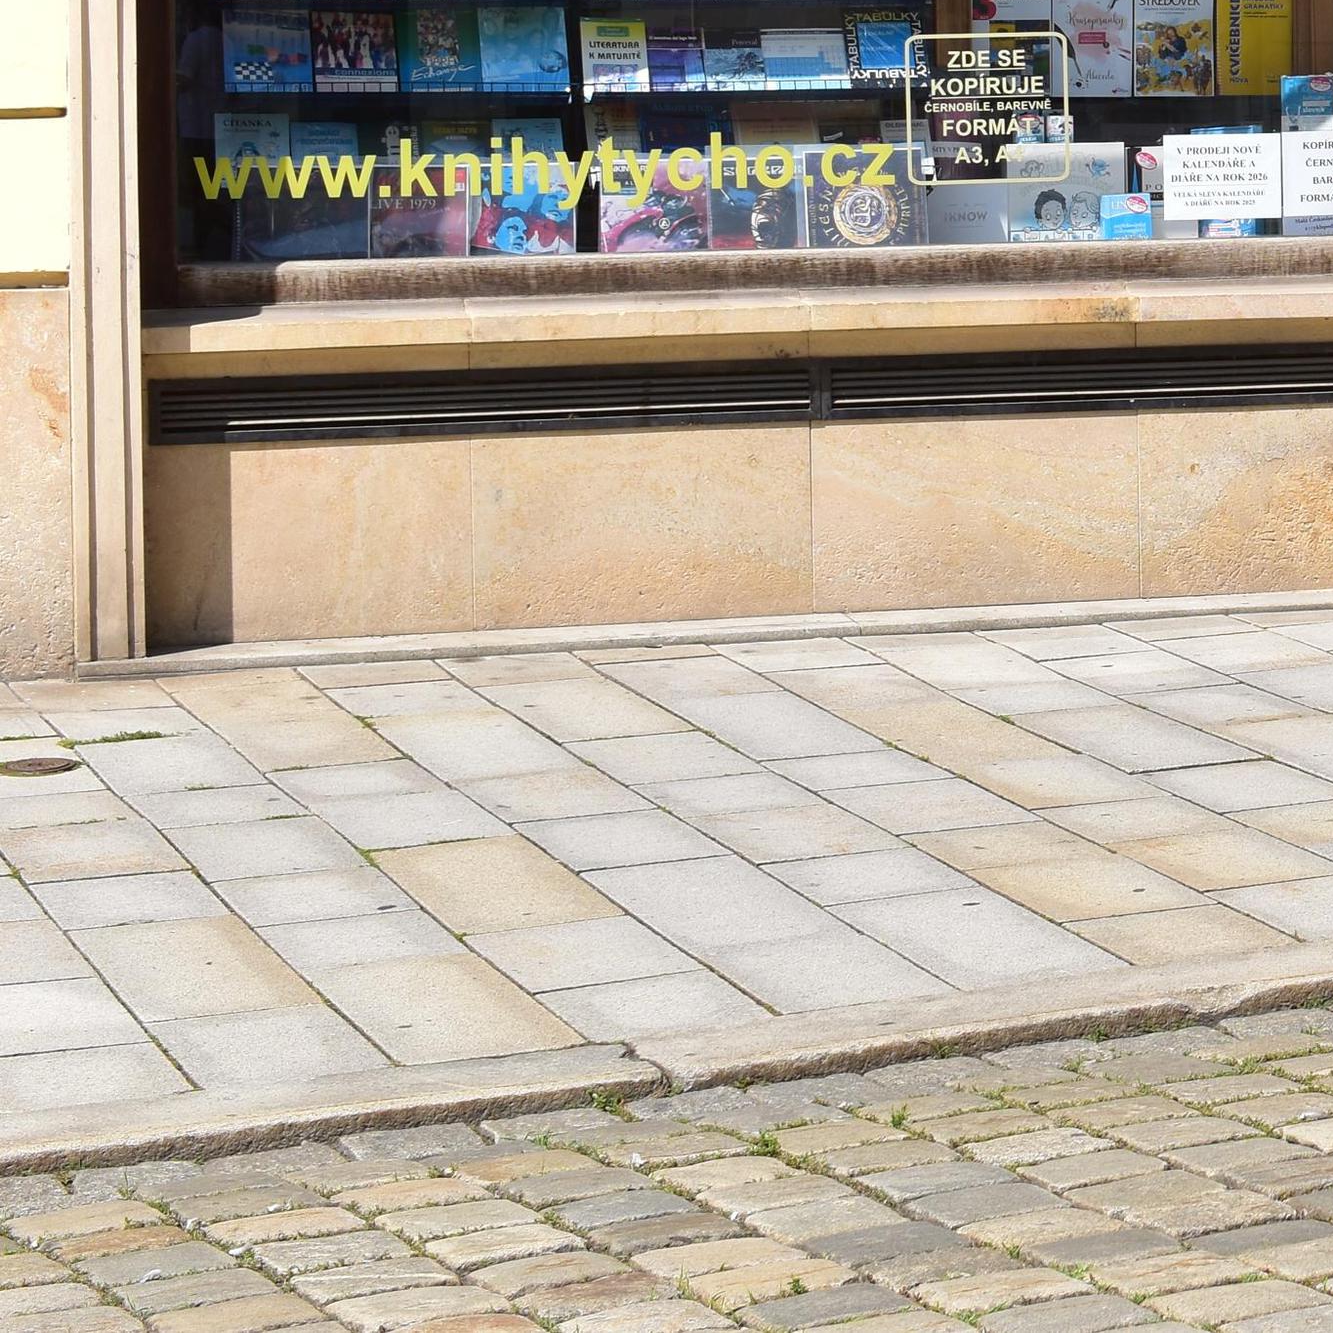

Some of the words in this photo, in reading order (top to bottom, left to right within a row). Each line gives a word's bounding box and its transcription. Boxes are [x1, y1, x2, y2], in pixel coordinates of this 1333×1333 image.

[852, 11, 919, 22] TABULKY
[589, 41, 640, 49] LITERATURA
[947, 50, 992, 68] ZDE
[998, 49, 1026, 67] SE
[930, 74, 1044, 96] KOPÍRUJE
[924, 100, 995, 114] ČERNOBÍLE,
[996, 99, 1052, 111] BAREVNĚ
[943, 112, 1035, 136] FORMÁT
[954, 147, 990, 166] A3,
[995, 145, 1024, 164] A4
[1176, 146, 1184, 155] V
[1186, 146, 1230, 155] PRODEJI
[1232, 143, 1262, 155] NOVÉ
[1182, 158, 1246, 169] KALENDÁŘE
[1248, 159, 1256, 168] A
[193, 131, 896, 210] www.knihytycho.cz
[1170, 172, 1204, 183] DIÁŘE
[1206, 173, 1220, 183] NA
[1222, 173, 1246, 182] ROK
[1248, 172, 1268, 181] 2026
[409, 198, 437, 209] 1979
